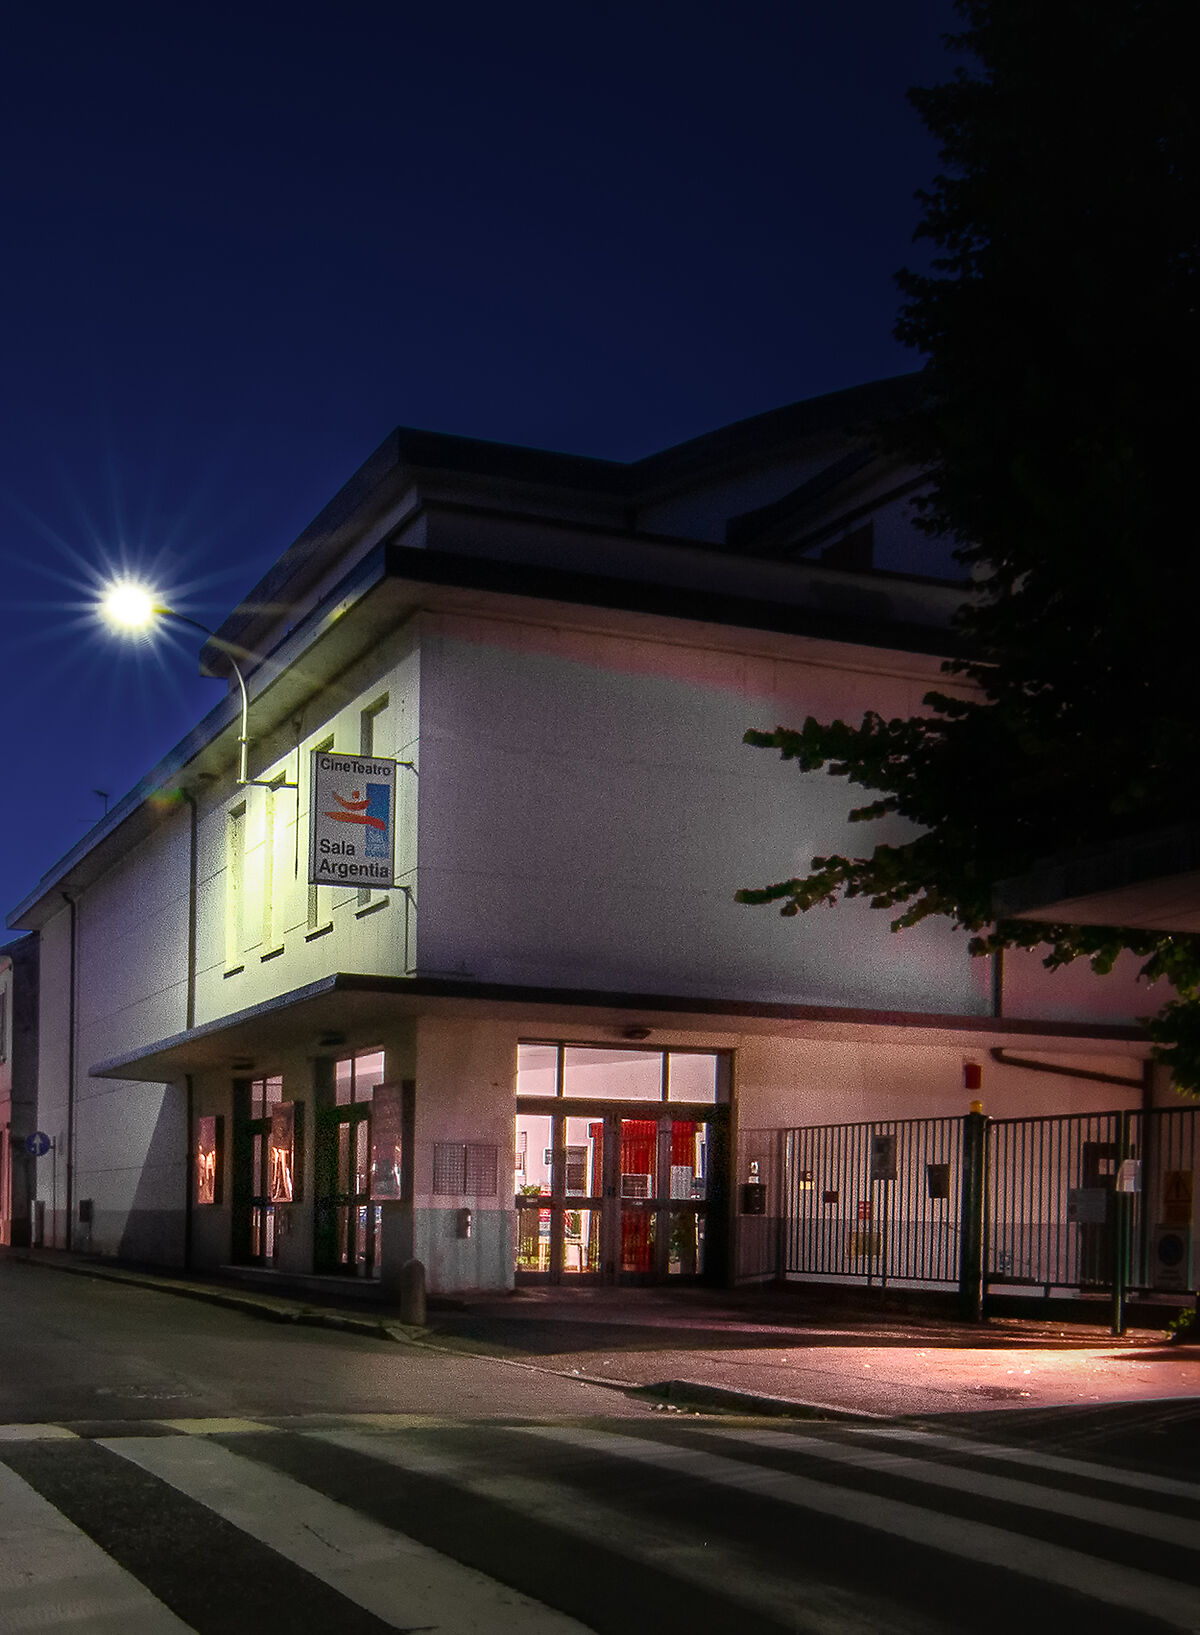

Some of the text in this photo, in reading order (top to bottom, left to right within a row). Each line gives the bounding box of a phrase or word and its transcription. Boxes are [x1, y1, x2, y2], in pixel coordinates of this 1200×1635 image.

[320, 757, 391, 776] CineTeatro
[319, 838, 356, 856] Sala
[319, 858, 389, 878] Argentia
